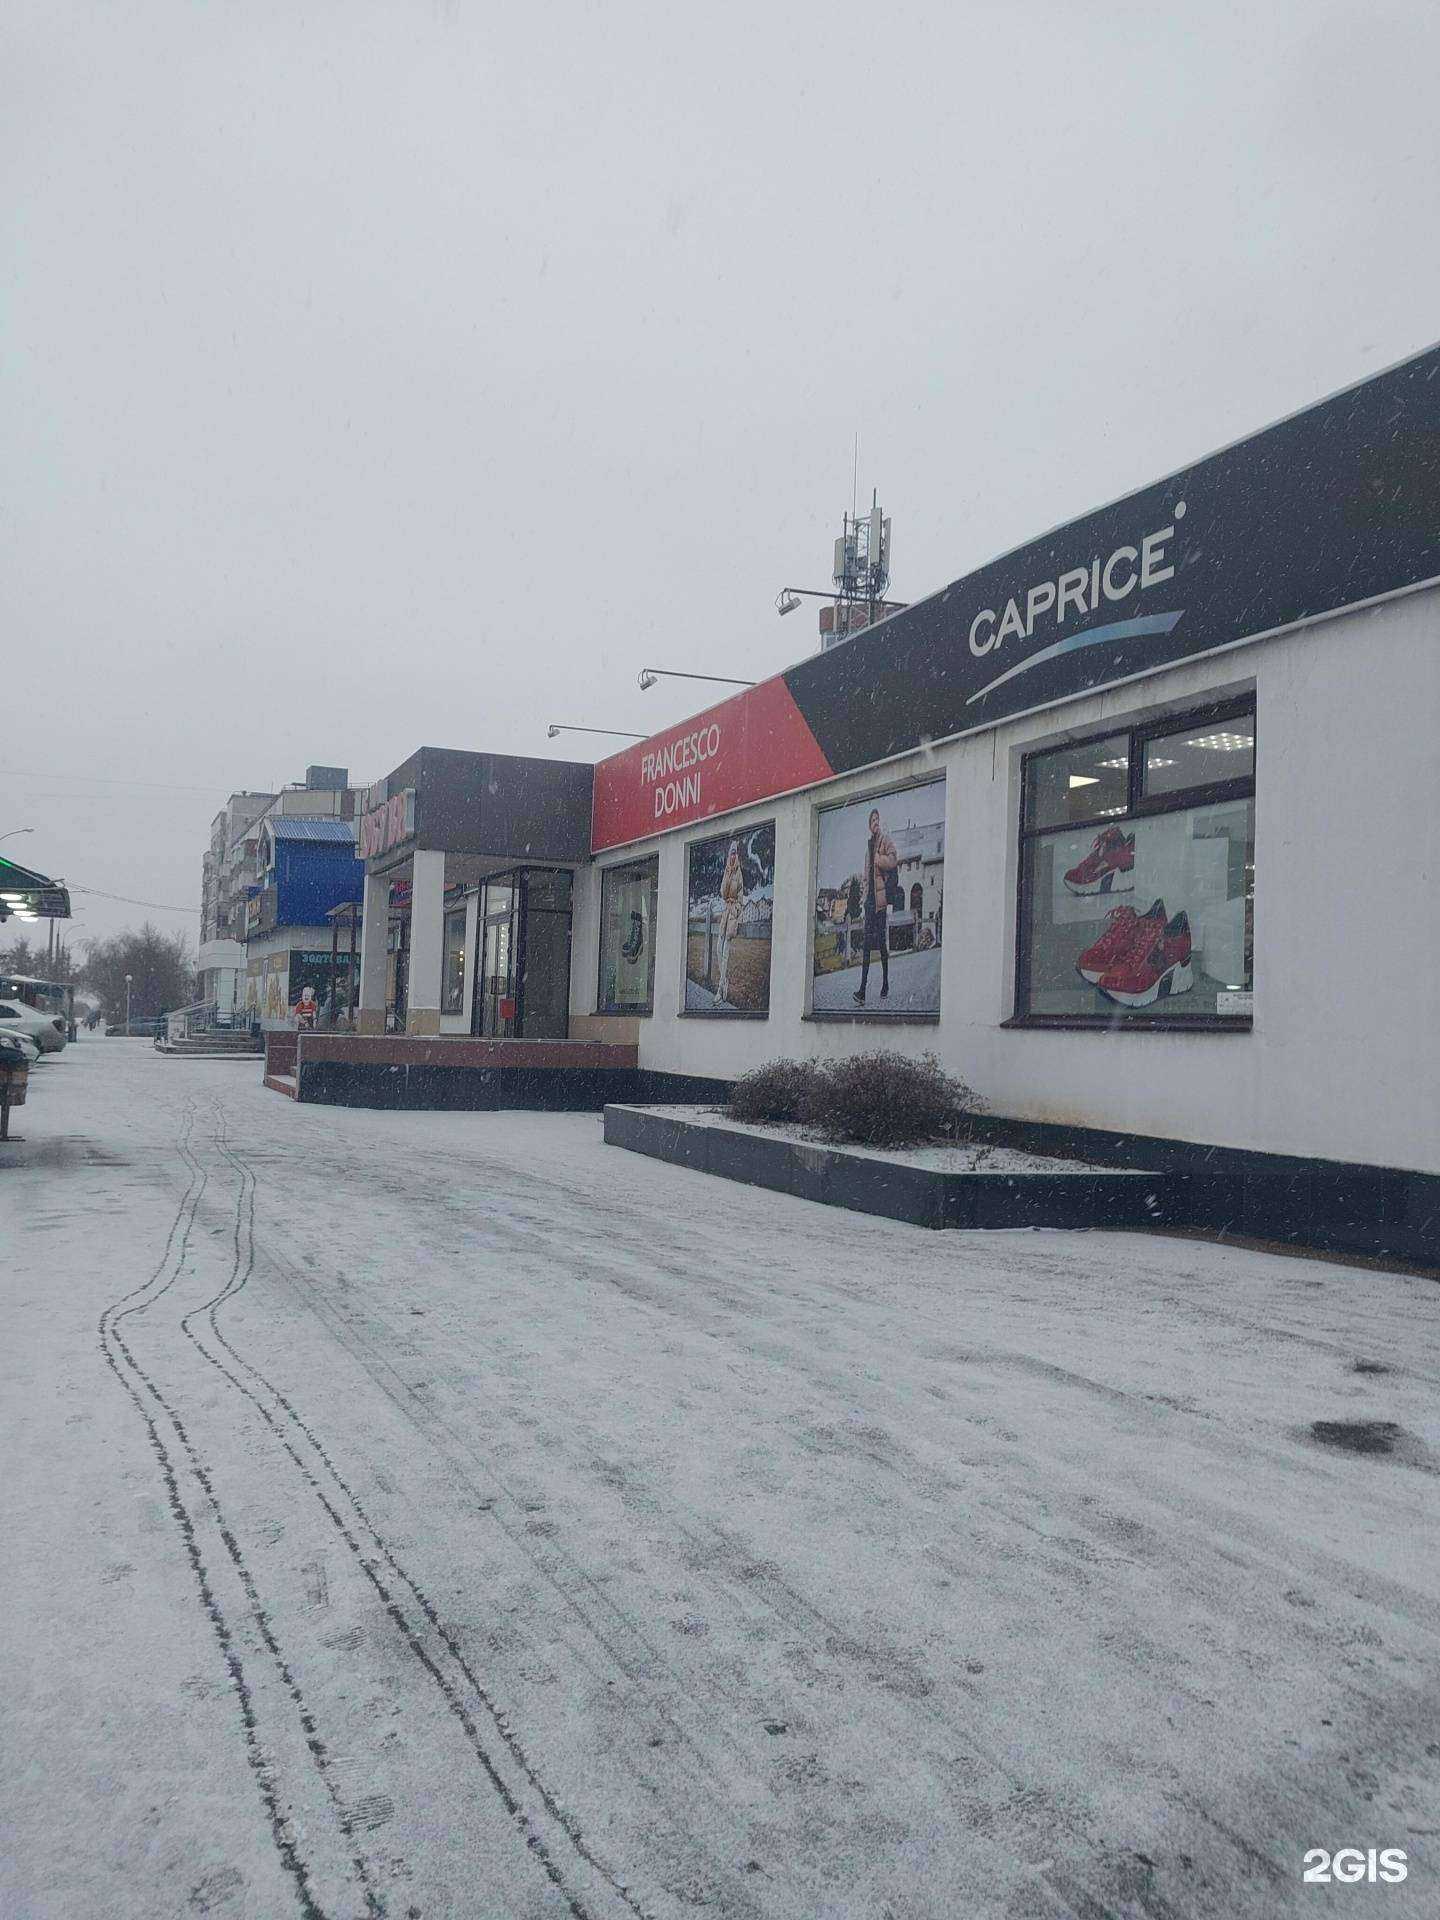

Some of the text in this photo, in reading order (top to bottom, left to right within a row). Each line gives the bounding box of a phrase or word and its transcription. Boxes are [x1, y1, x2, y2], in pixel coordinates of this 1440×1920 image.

[969, 526, 1174, 657] CAPRICE
[641, 724, 719, 786] FRANCESCO
[654, 771, 701, 818] DONNI
